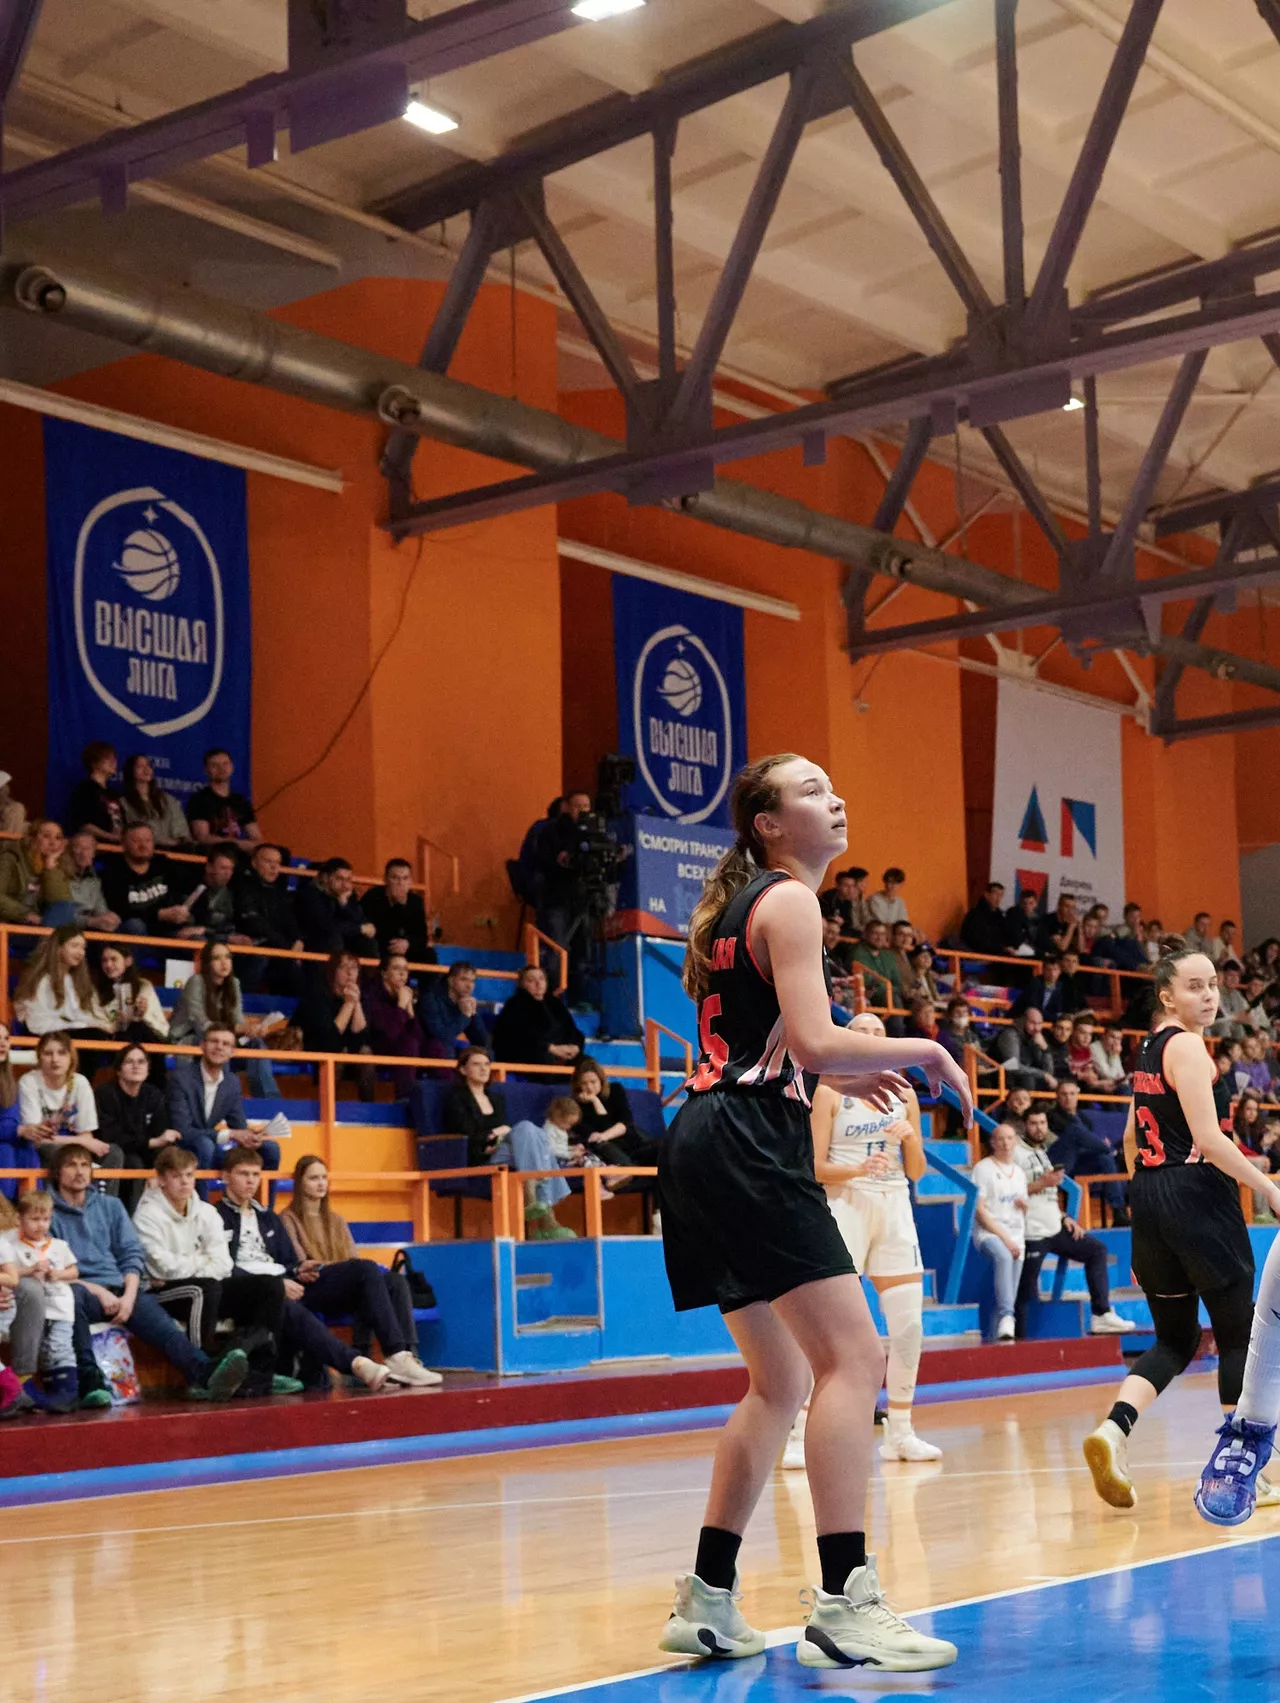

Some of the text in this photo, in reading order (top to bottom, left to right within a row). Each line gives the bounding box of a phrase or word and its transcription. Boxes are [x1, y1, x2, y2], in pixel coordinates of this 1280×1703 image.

[95, 599, 208, 664] ВЫСШАЯ
[126, 657, 178, 701] ЛИГА
[649, 716, 718, 768] ВЫСШАЯ
[667, 761, 704, 797] ЛИГА
[649, 898, 666, 912] НА
